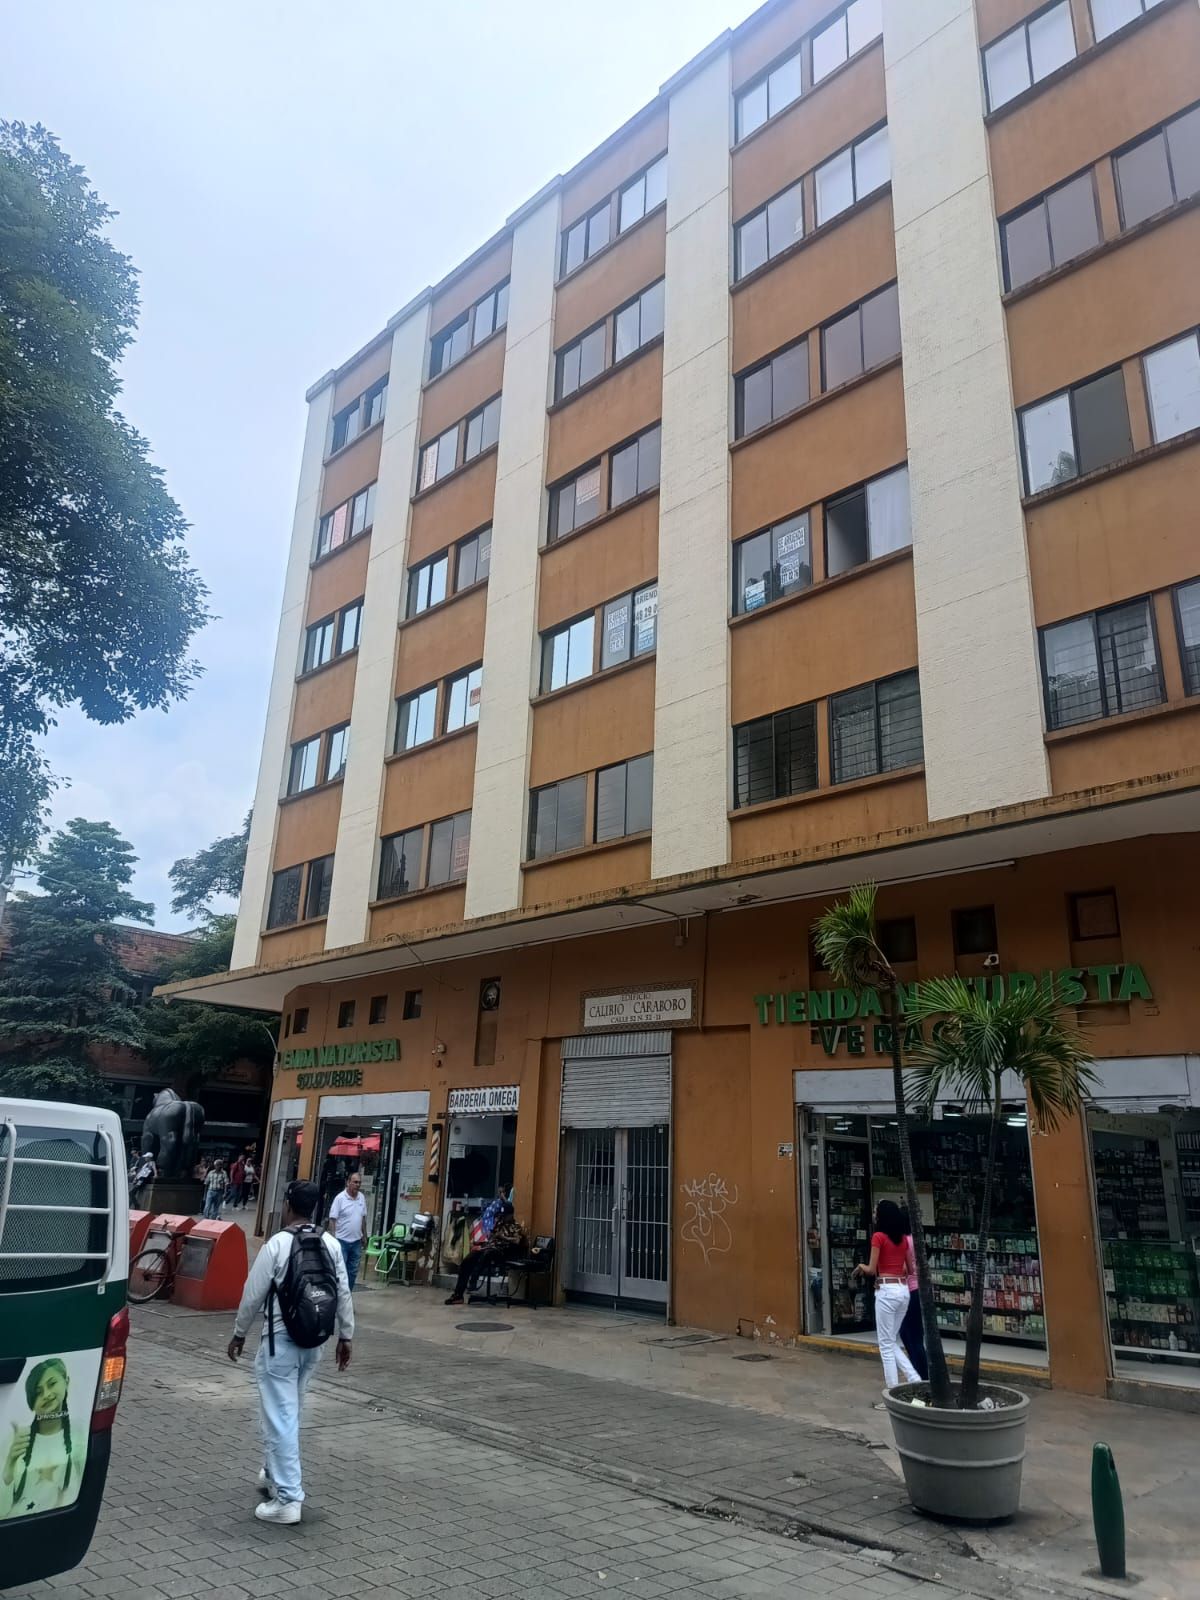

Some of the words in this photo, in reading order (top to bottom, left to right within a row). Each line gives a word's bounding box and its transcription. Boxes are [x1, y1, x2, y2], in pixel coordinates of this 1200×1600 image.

[754, 984, 884, 1025] TIENDA
[896, 963, 1153, 1016] NURISTA
[589, 1003, 625, 1018] CALIBIO
[633, 997, 687, 1014] CARABOBO
[319, 1038, 402, 1067] NATURISTA
[449, 1092, 487, 1108] BARBERIA
[488, 1090, 517, 1106] OMEGA
